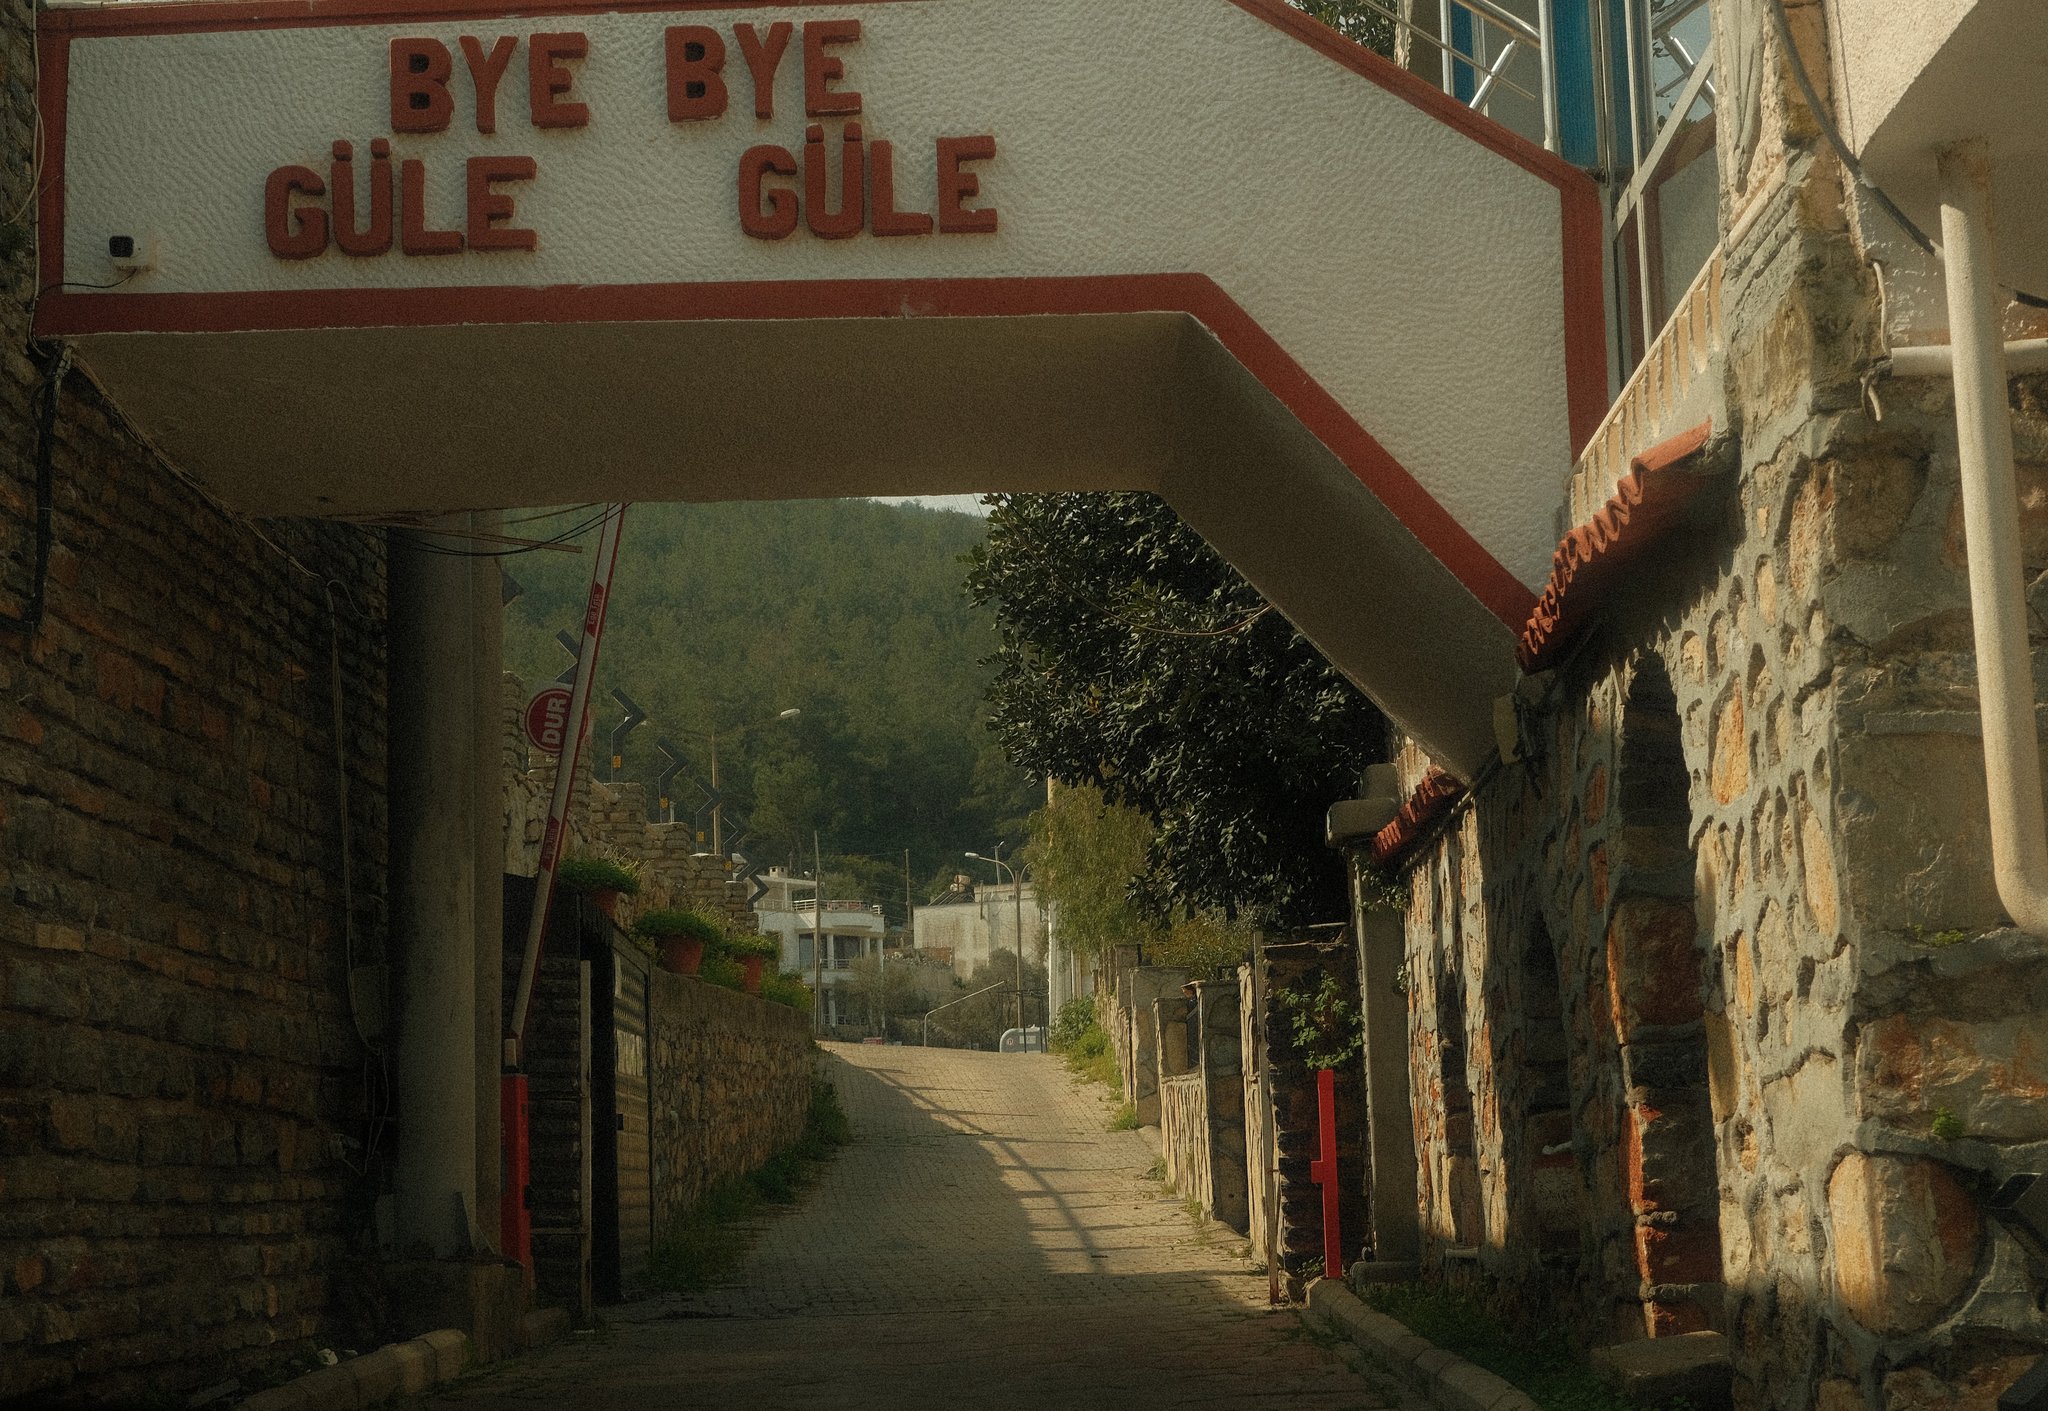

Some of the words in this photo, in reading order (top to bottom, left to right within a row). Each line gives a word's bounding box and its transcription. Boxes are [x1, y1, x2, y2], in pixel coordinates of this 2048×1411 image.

[390, 32, 590, 134] BYE
[664, 19, 863, 123] BYE
[264, 137, 538, 260] GÜLE
[738, 121, 998, 240] GÜLE
[541, 697, 567, 745] DUR
